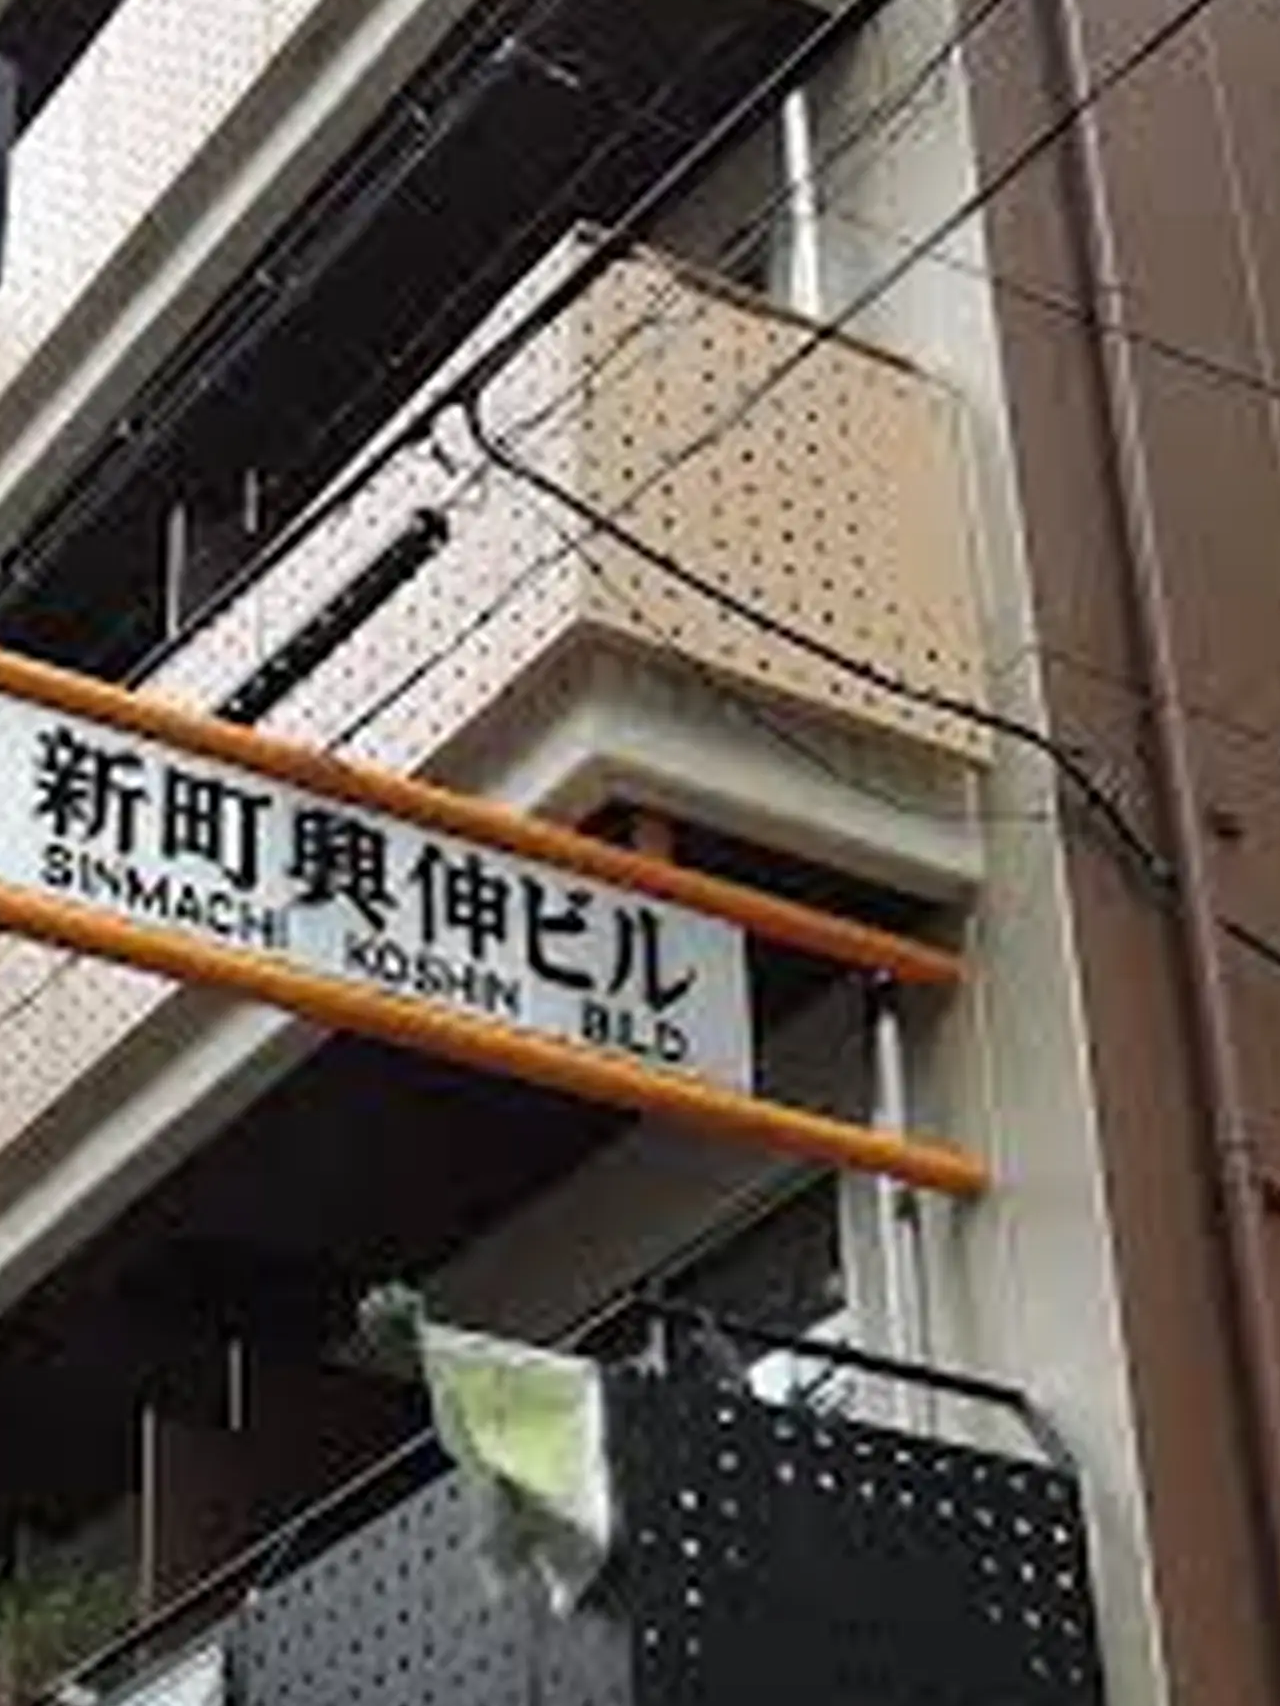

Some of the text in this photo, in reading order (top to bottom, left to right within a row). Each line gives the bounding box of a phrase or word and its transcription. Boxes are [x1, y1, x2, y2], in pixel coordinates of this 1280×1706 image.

[35, 724, 698, 1010] 新町興伸ビル
[40, 842, 290, 950] SINMACHI
[345, 930, 522, 1018] KOSHIN
